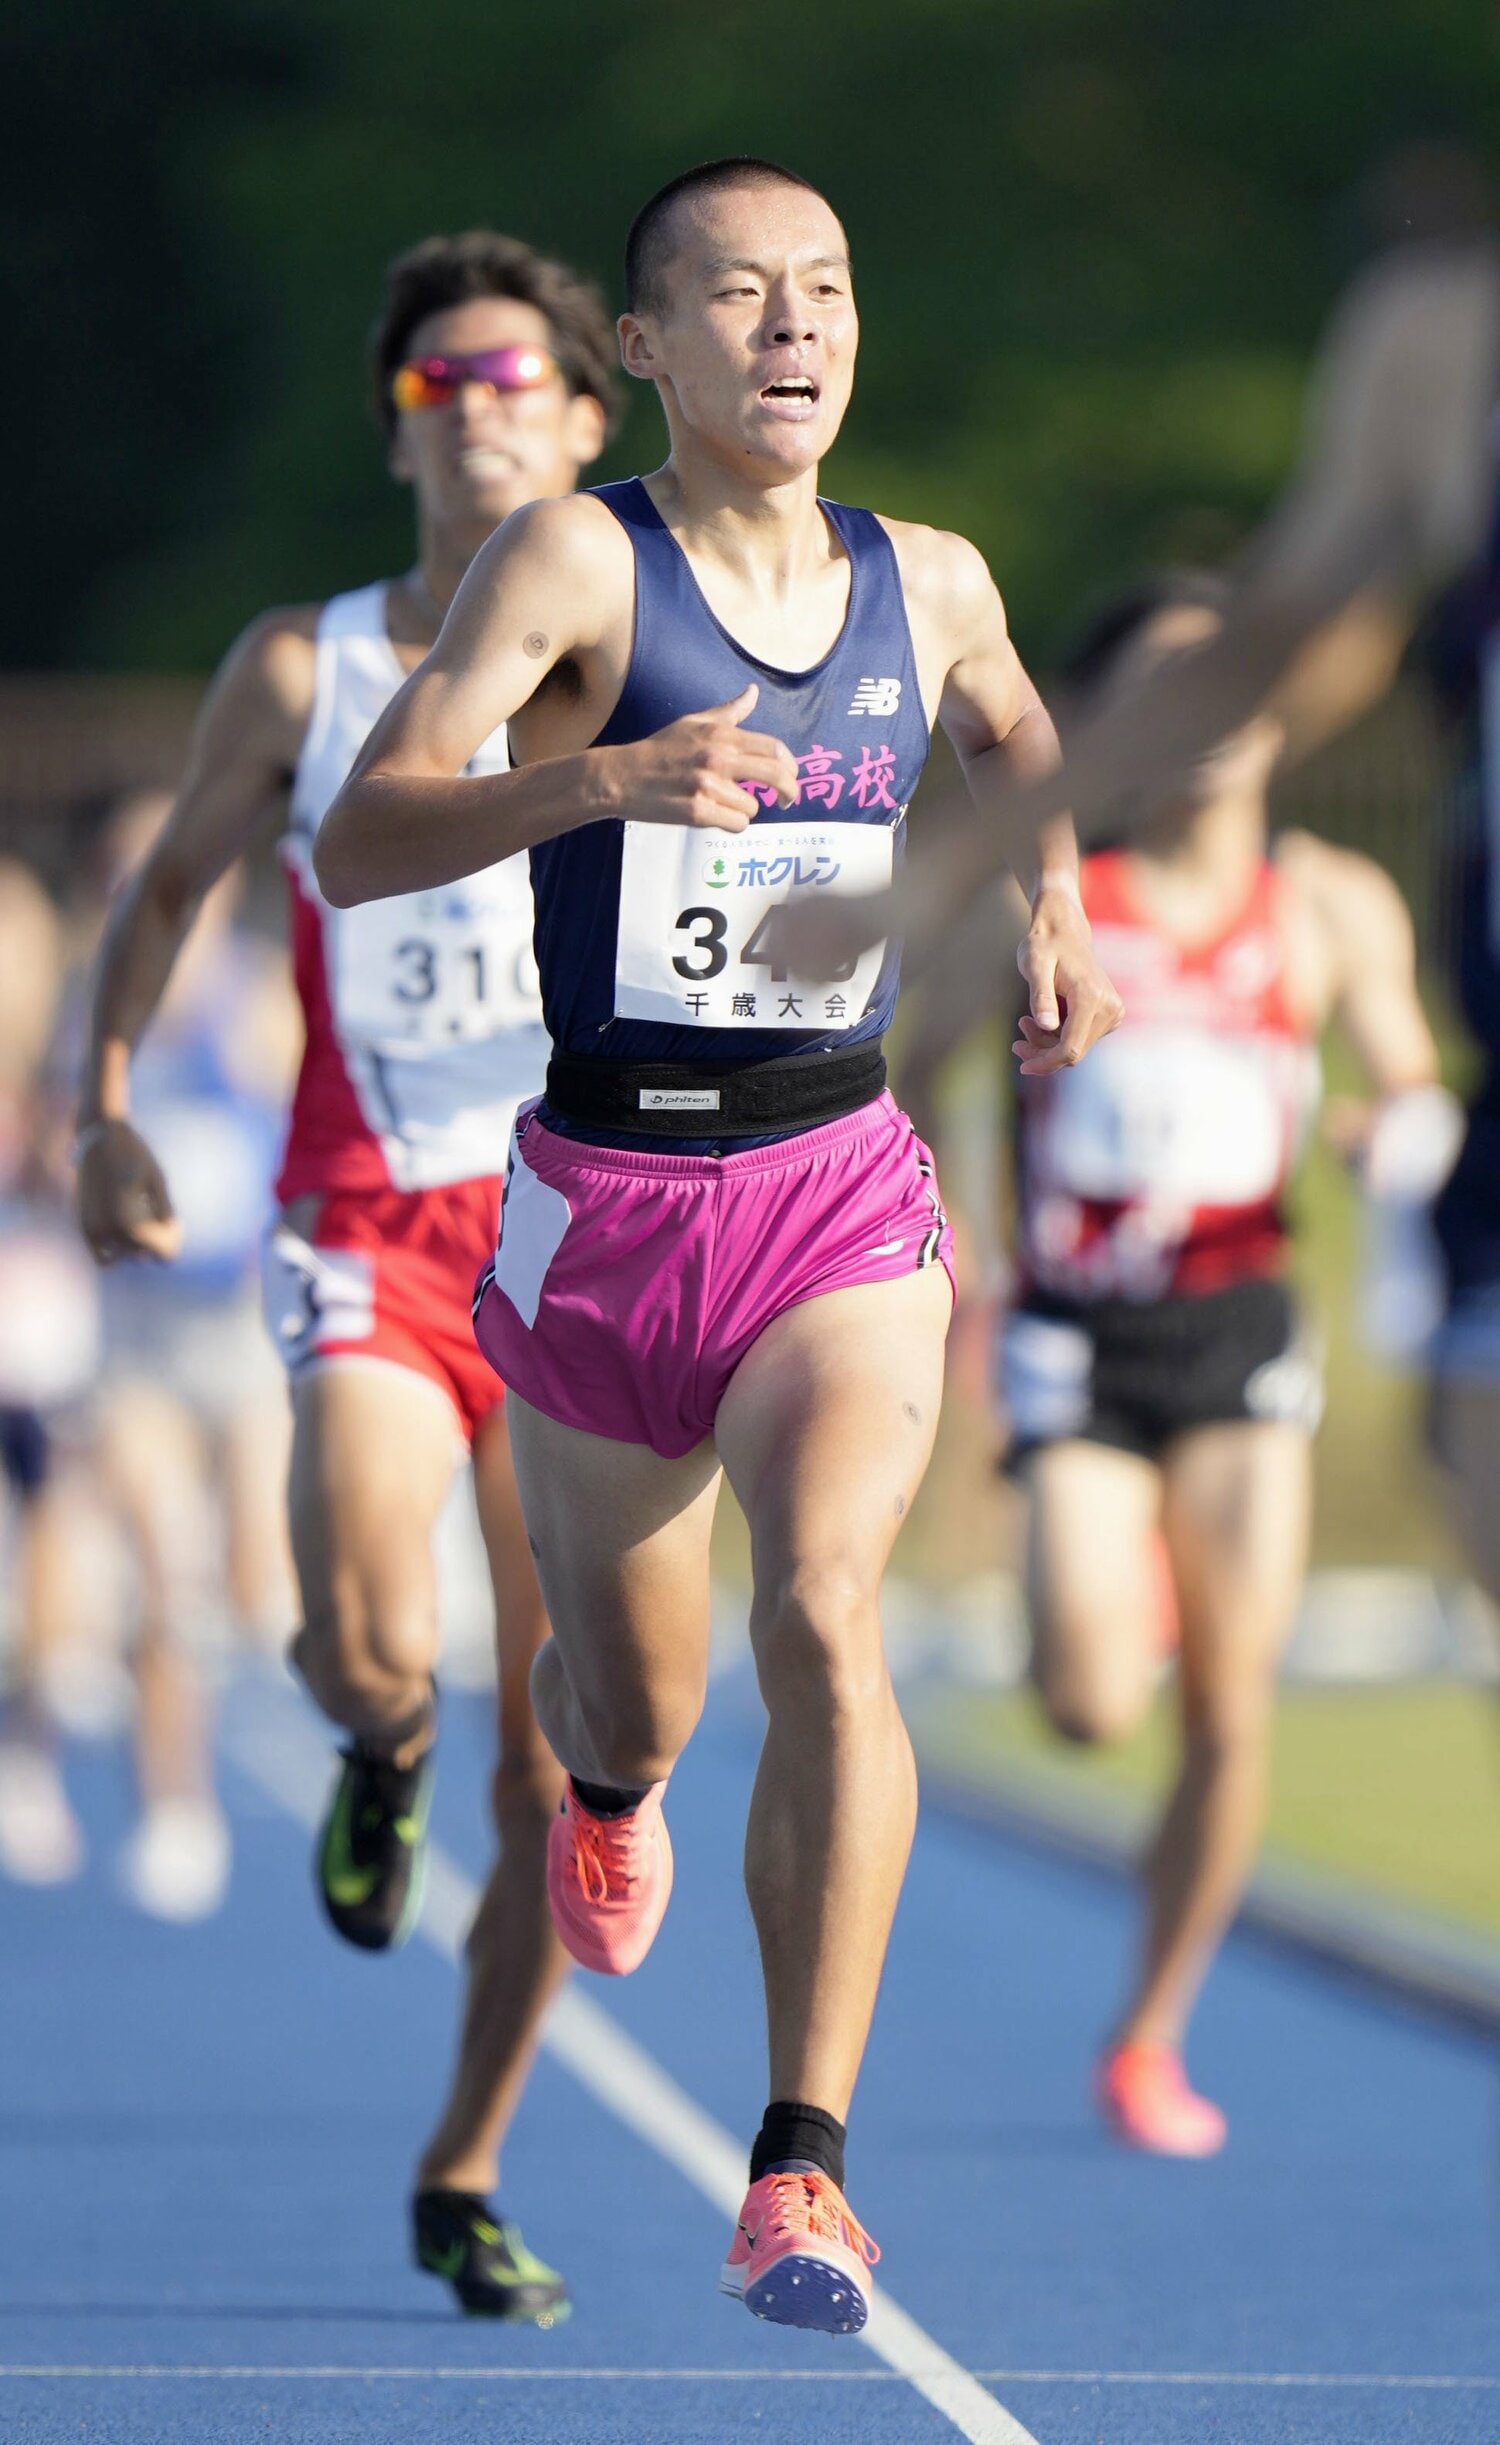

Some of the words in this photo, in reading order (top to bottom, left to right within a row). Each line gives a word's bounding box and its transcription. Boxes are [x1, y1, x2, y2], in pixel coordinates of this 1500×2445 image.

[737, 856, 841, 886] ホクレン
[672, 904, 859, 982] 34
[685, 992, 847, 1019] 千歳大会
